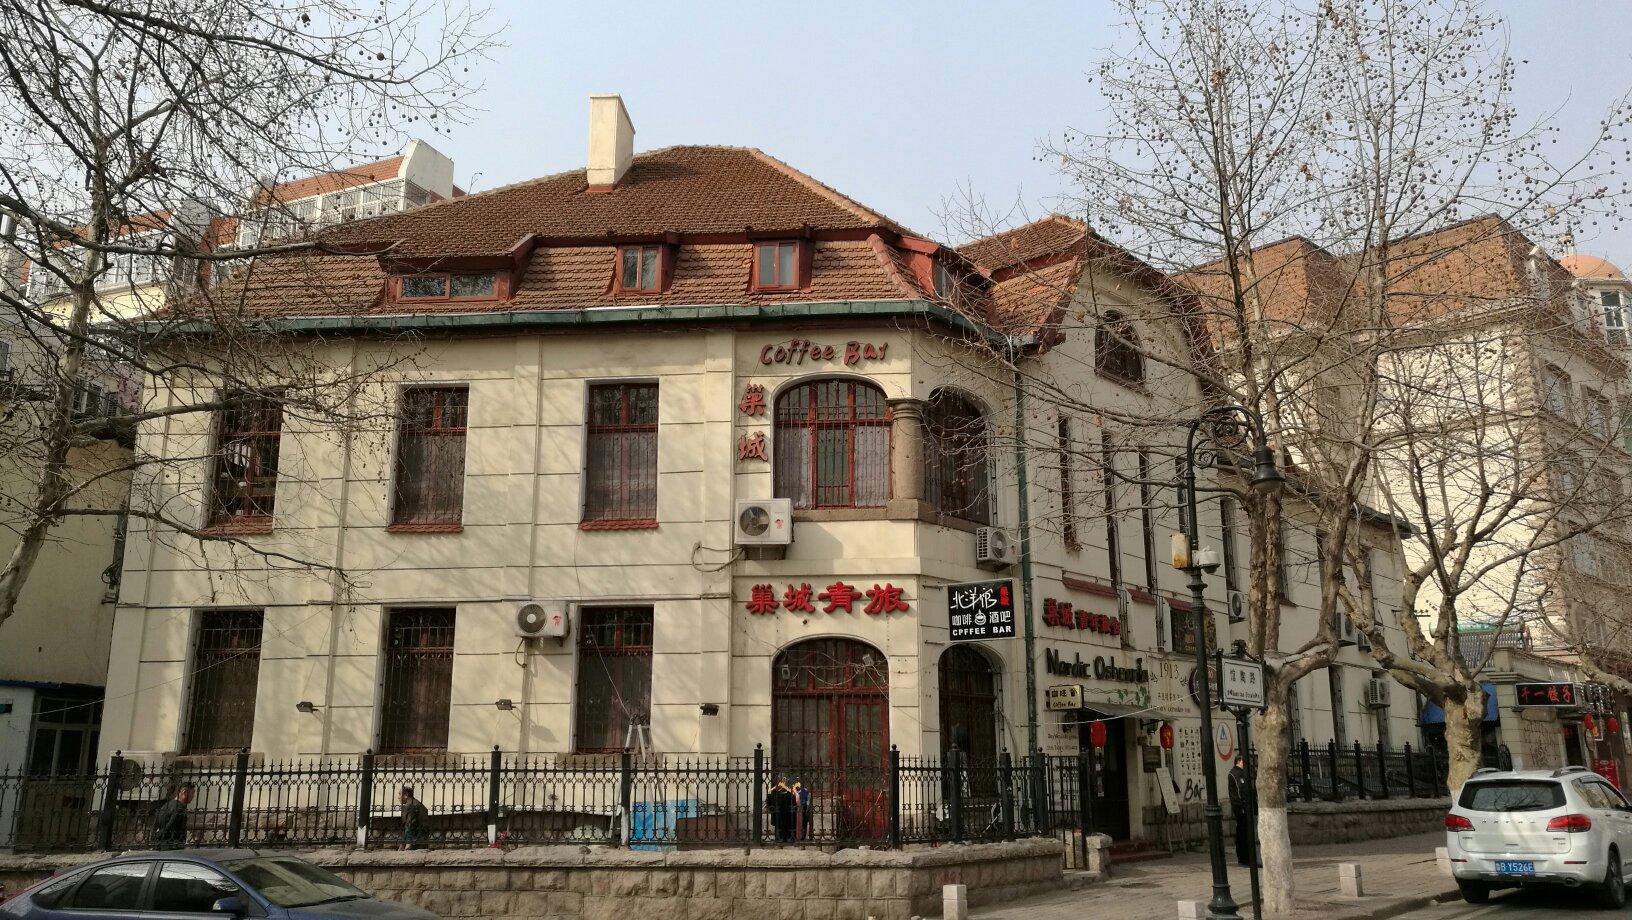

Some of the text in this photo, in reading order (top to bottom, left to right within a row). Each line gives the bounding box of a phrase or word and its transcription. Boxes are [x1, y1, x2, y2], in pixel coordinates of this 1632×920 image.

[760, 338, 889, 365] Coffee Bar
[746, 581, 910, 616] 巢城青旅
[952, 610, 1011, 626] 咖啡 酒吧
[953, 625, 1012, 636] CPFFEE BAR
[1046, 647, 1091, 679] Nordic
[1160, 662, 1179, 680] 1913
